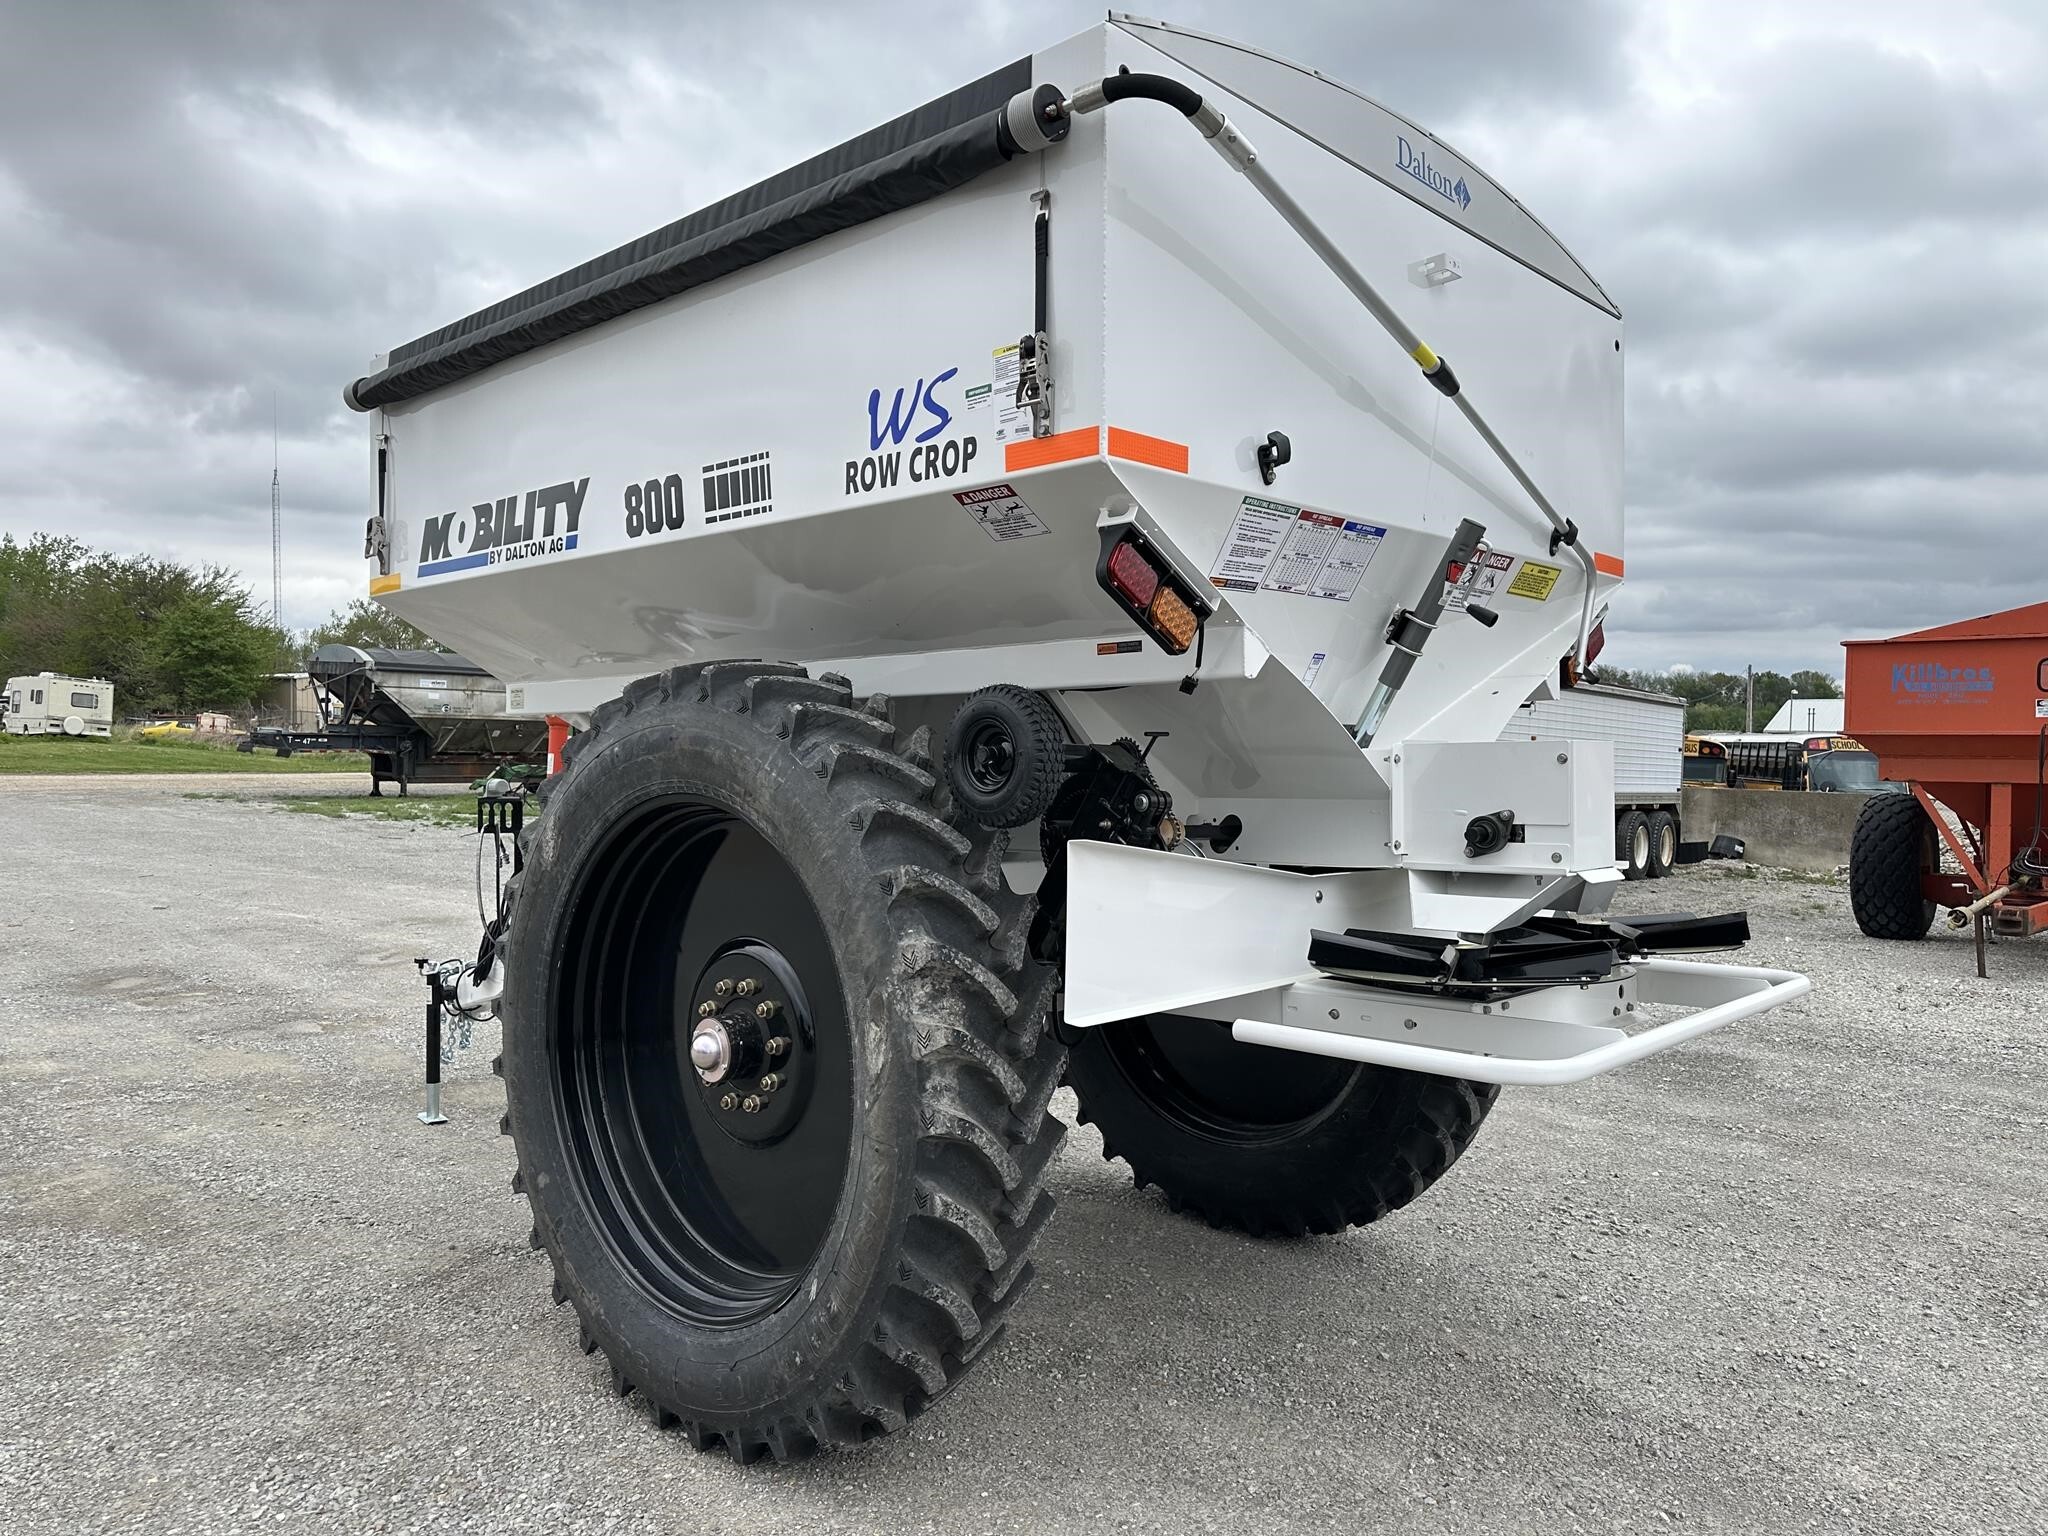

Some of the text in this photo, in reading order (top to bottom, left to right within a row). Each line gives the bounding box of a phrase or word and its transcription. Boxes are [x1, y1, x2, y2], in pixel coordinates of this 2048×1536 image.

[1397, 136, 1454, 199] Dalton
[868, 367, 958, 451] WS
[845, 436, 977, 495] ROW CROP
[624, 473, 685, 538] 800
[970, 486, 1012, 501] DANGER
[1246, 497, 1269, 508] OPERATING
[419, 477, 590, 563] MOBILITY
[489, 537, 563, 564] BY DALTON AG
[1684, 743, 1698, 753] BUS
[1831, 740, 1862, 750] SCHOOL
